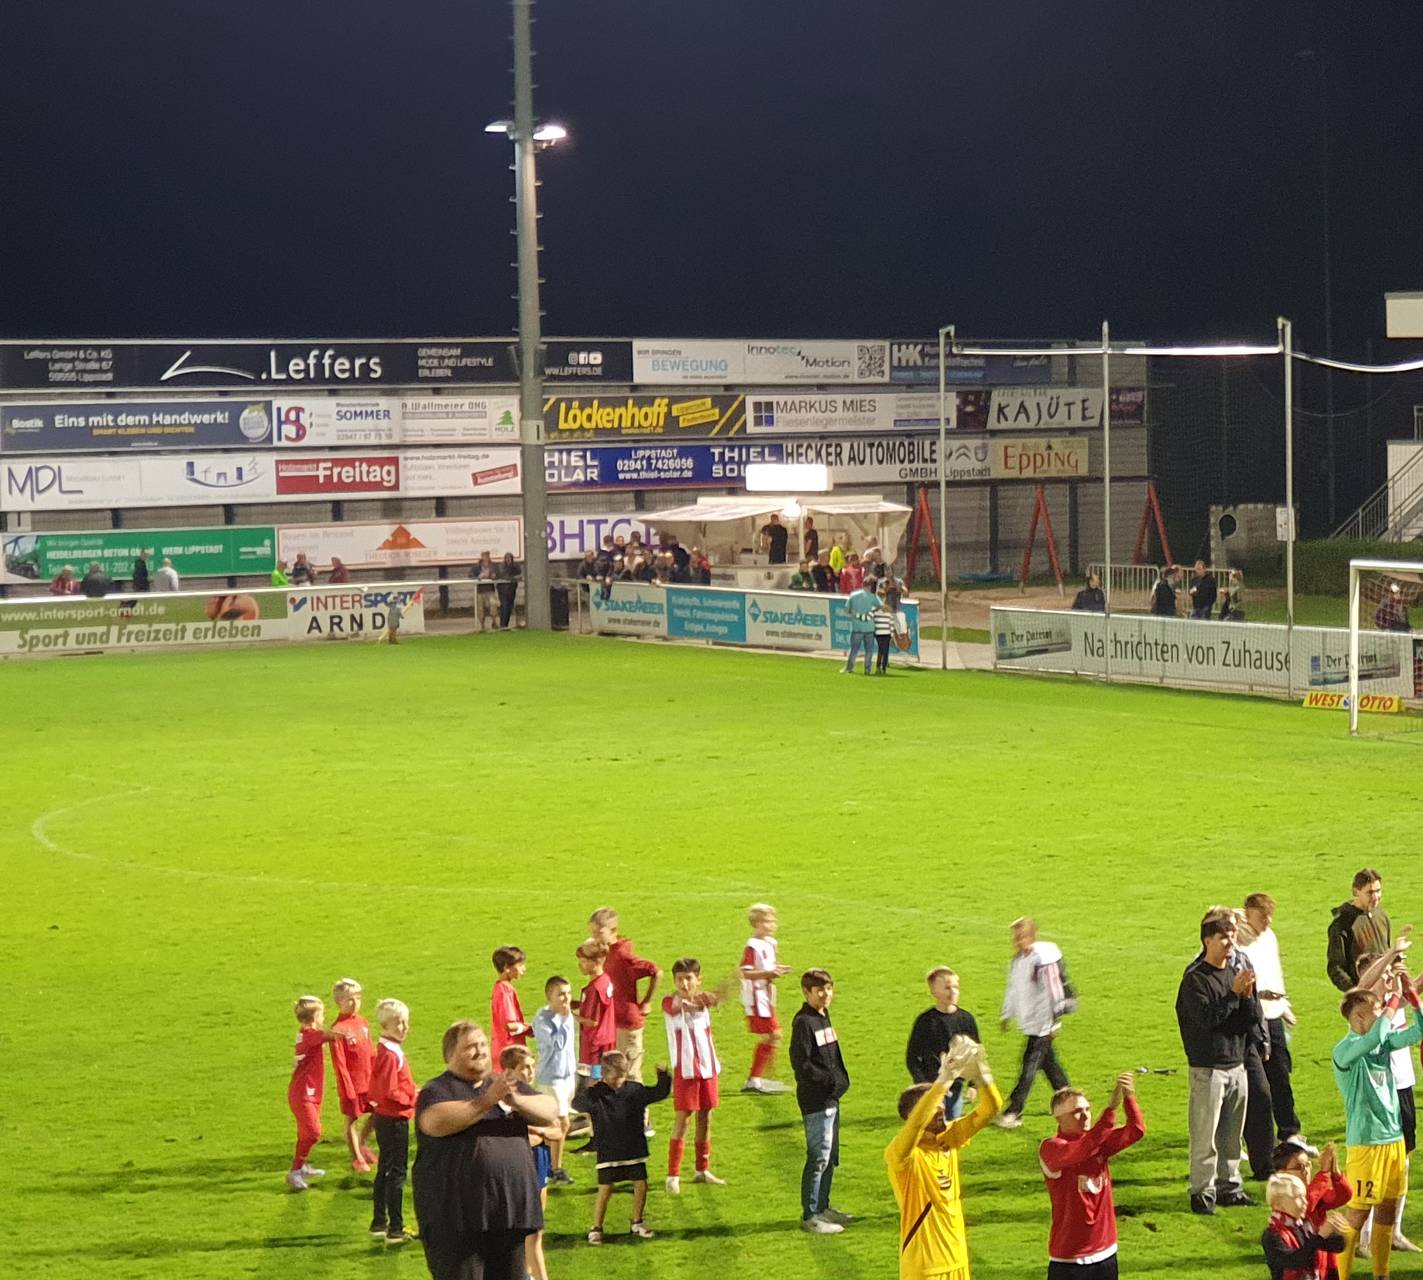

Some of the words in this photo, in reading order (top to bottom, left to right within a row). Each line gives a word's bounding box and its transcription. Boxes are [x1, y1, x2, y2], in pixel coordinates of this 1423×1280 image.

[652, 359, 728, 373] BEWEGUNG
[804, 356, 850, 368] Motion
[558, 398, 670, 430] Löckenhoff
[776, 400, 838, 414] MARKUS
[842, 399, 877, 413] MIES
[996, 395, 1095, 426] KAJÜTE
[54, 415, 85, 428] Eins
[88, 413, 115, 427] mit
[117, 412, 149, 426] dem
[152, 411, 229, 425] Handwerk!
[335, 409, 391, 420] SOMMER
[776, 416, 877, 428] Fliesenlegermeister
[544, 451, 599, 466] HIEL
[631, 450, 678, 459] LIPPSTADT
[710, 447, 777, 462] THIEL
[784, 442, 843, 467] HECKER
[847, 440, 938, 466] AUTOMOBILE
[617, 460, 647, 471] 02941
[898, 467, 938, 479] GMBH
[318, 461, 396, 487] Freitag
[545, 468, 599, 482] OLAR
[618, 469, 693, 480] www.thiel-solar.de
[7, 465, 84, 502] MDL
[17, 626, 69, 652] Sport
[75, 624, 111, 646] und
[116, 623, 188, 644] Freizeit
[194, 621, 262, 640] erleben
[1185, 641, 1217, 666] von
[1221, 640, 1291, 674] Zuhause
[1308, 693, 1345, 707] WEST
[1356, 1180, 1375, 1198] 12
